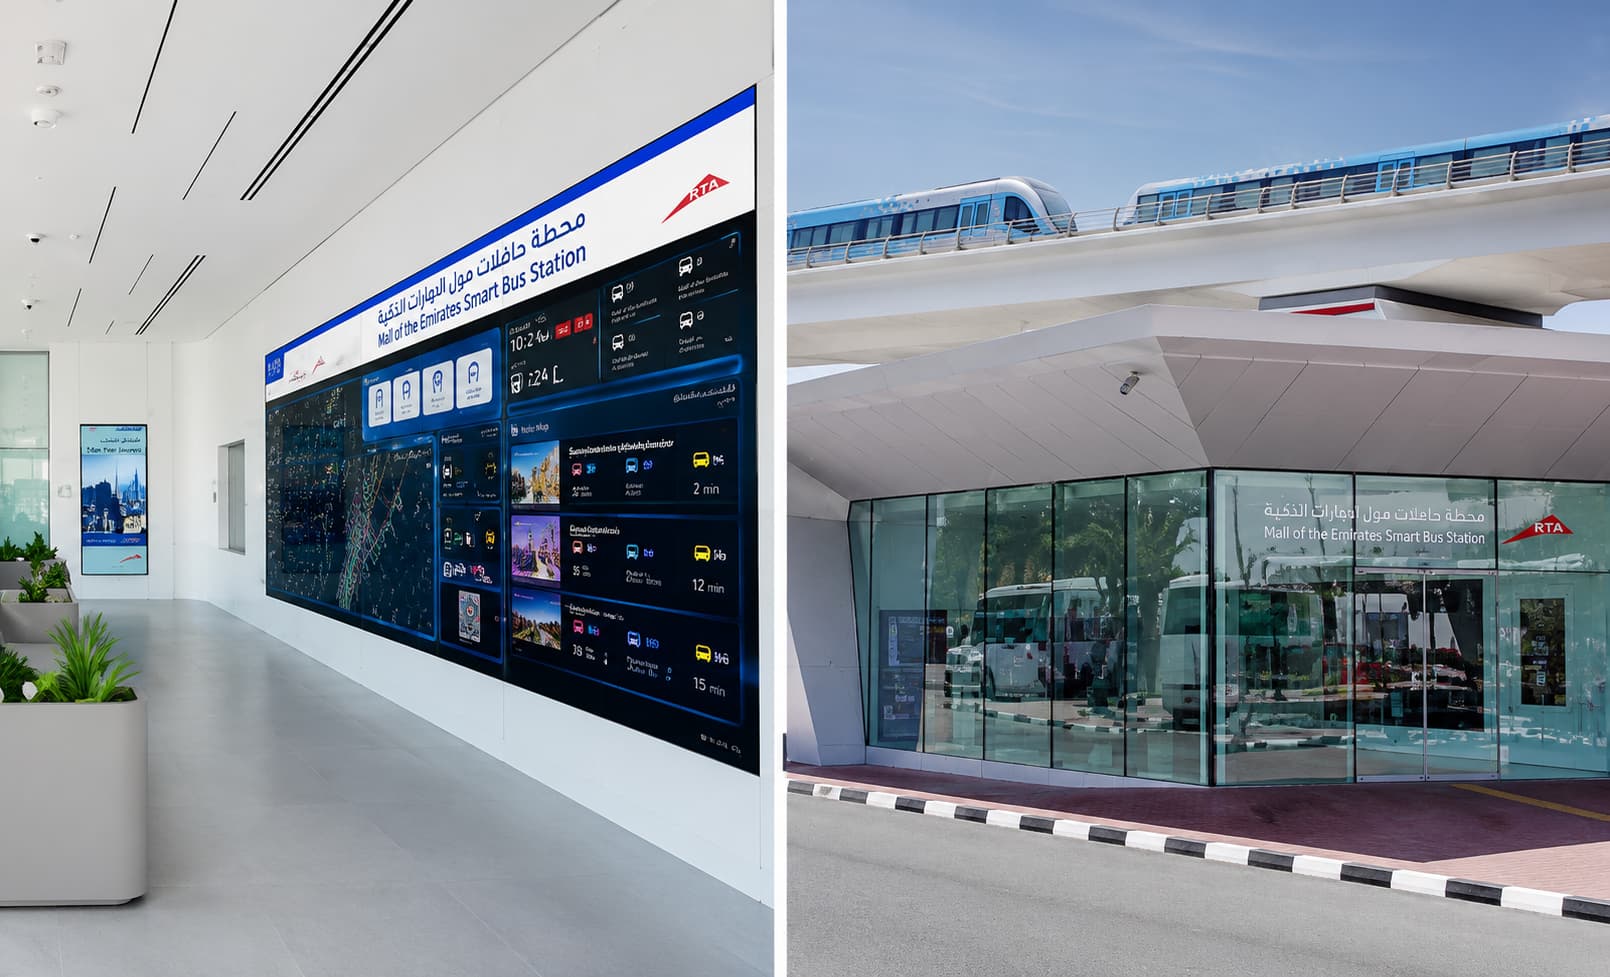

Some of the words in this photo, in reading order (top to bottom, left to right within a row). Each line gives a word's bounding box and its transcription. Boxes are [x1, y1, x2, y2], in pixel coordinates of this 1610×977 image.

[689, 178, 719, 201] RTA
[531, 213, 586, 248] محطة
[477, 242, 526, 276] حافلات
[449, 270, 474, 295] مول
[378, 328, 393, 348] Mall
[394, 322, 403, 341] of
[404, 320, 418, 336] the
[420, 301, 462, 330] Emirates
[464, 282, 500, 311] Smart
[502, 271, 526, 295] Bus
[530, 245, 586, 283] Station
[693, 481, 700, 495] 2
[703, 483, 720, 494] min
[1264, 502, 1308, 521] الذكية
[1363, 506, 1390, 524] مول
[1445, 507, 1485, 522] محطة
[1264, 525, 1289, 539] Mall
[1293, 526, 1306, 539] of
[1308, 527, 1328, 540] the
[1331, 528, 1382, 541] Emirates
[1385, 529, 1420, 543] Smart
[1423, 530, 1443, 543] Bus
[1446, 531, 1485, 544] Station
[1534, 522, 1564, 533] RTA
[692, 578, 705, 592] 12
[707, 582, 725, 594] min
[693, 676, 706, 691] 15
[709, 684, 726, 697] min
